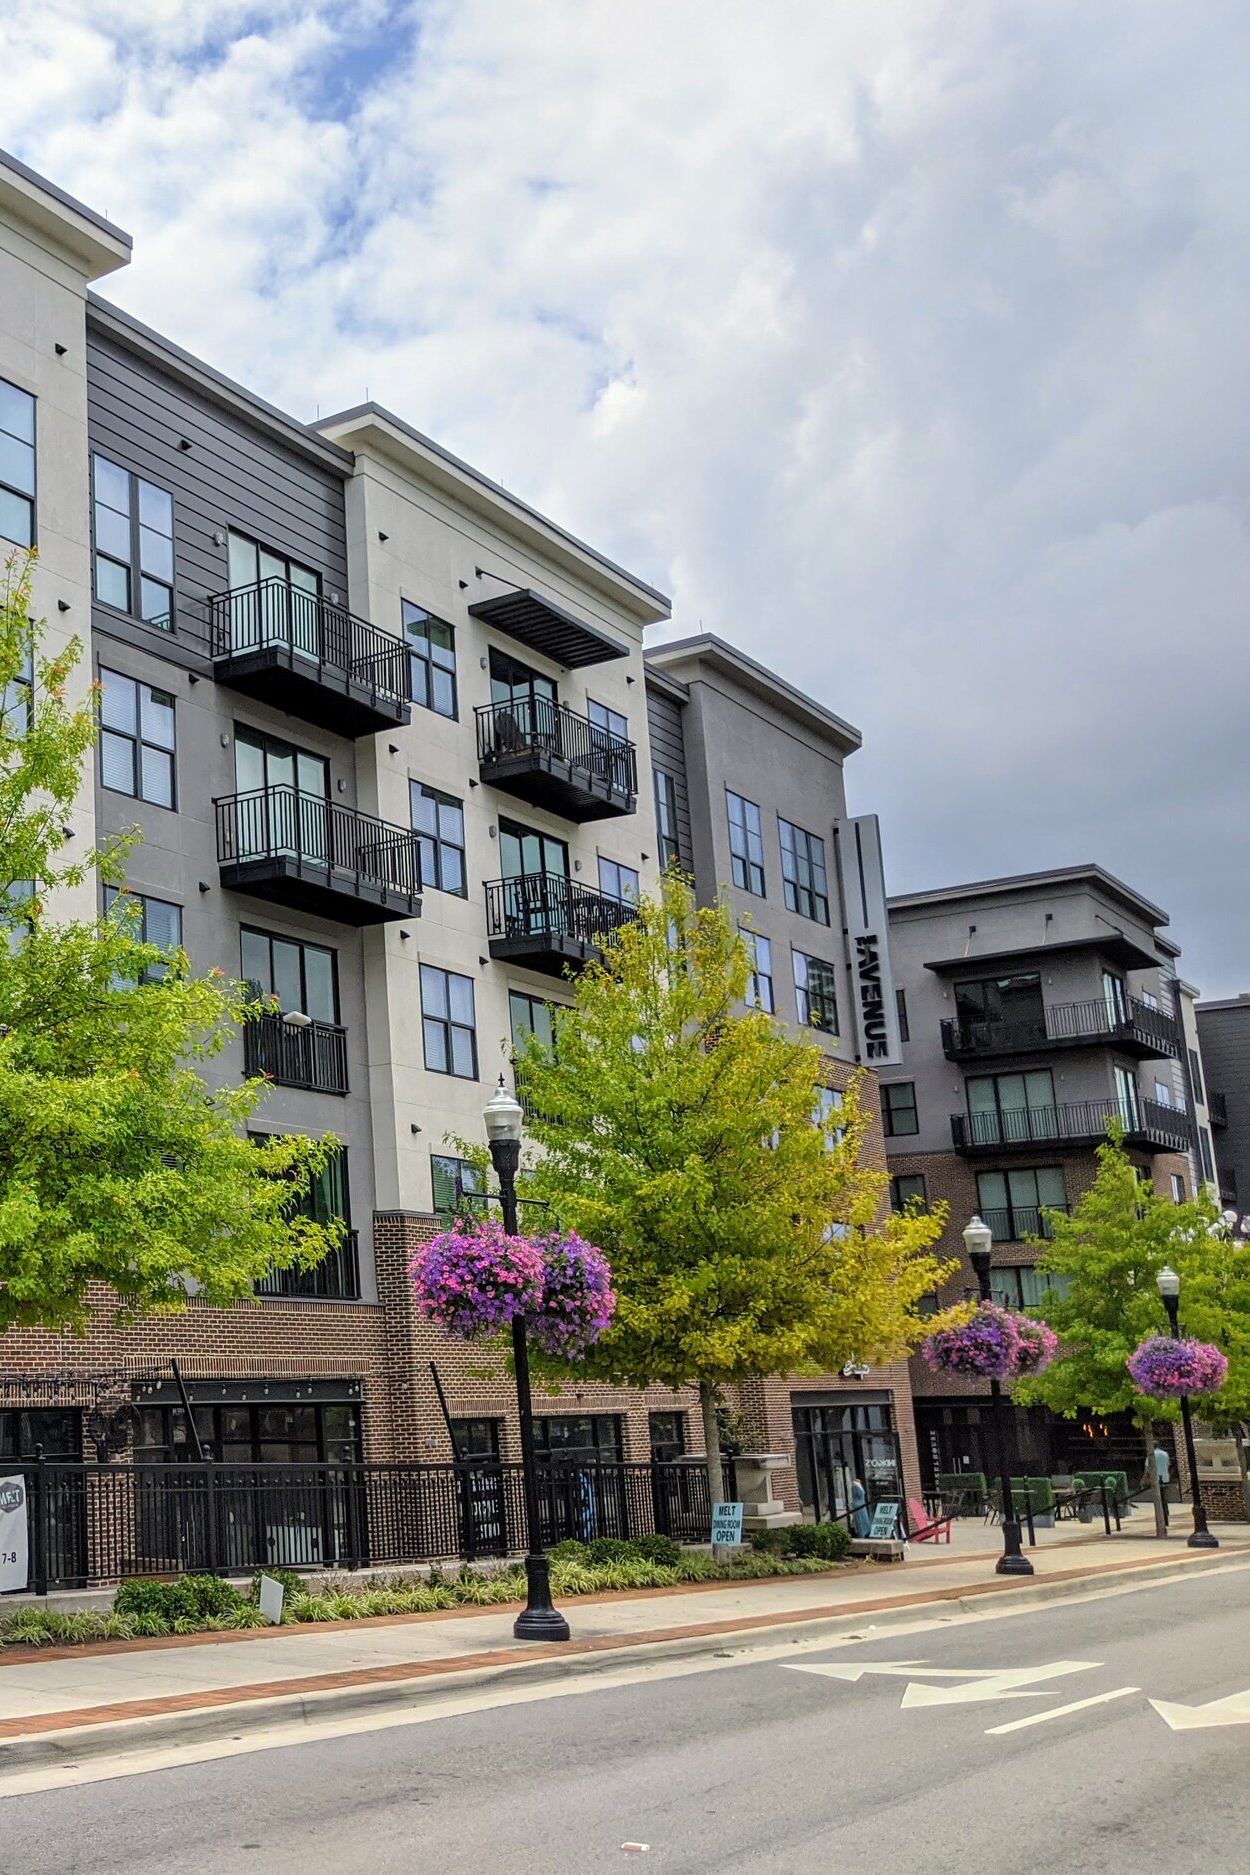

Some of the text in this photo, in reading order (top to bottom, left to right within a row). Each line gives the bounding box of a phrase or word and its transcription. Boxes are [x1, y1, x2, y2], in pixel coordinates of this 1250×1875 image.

[857, 946, 888, 1058] AVENUE
[719, 1506, 736, 1516] MELT
[879, 1505, 893, 1514] MELT
[716, 1530, 735, 1542] OPEN
[874, 1526, 888, 1536] OPEN
[2, 1552, 17, 1564] 7-8
